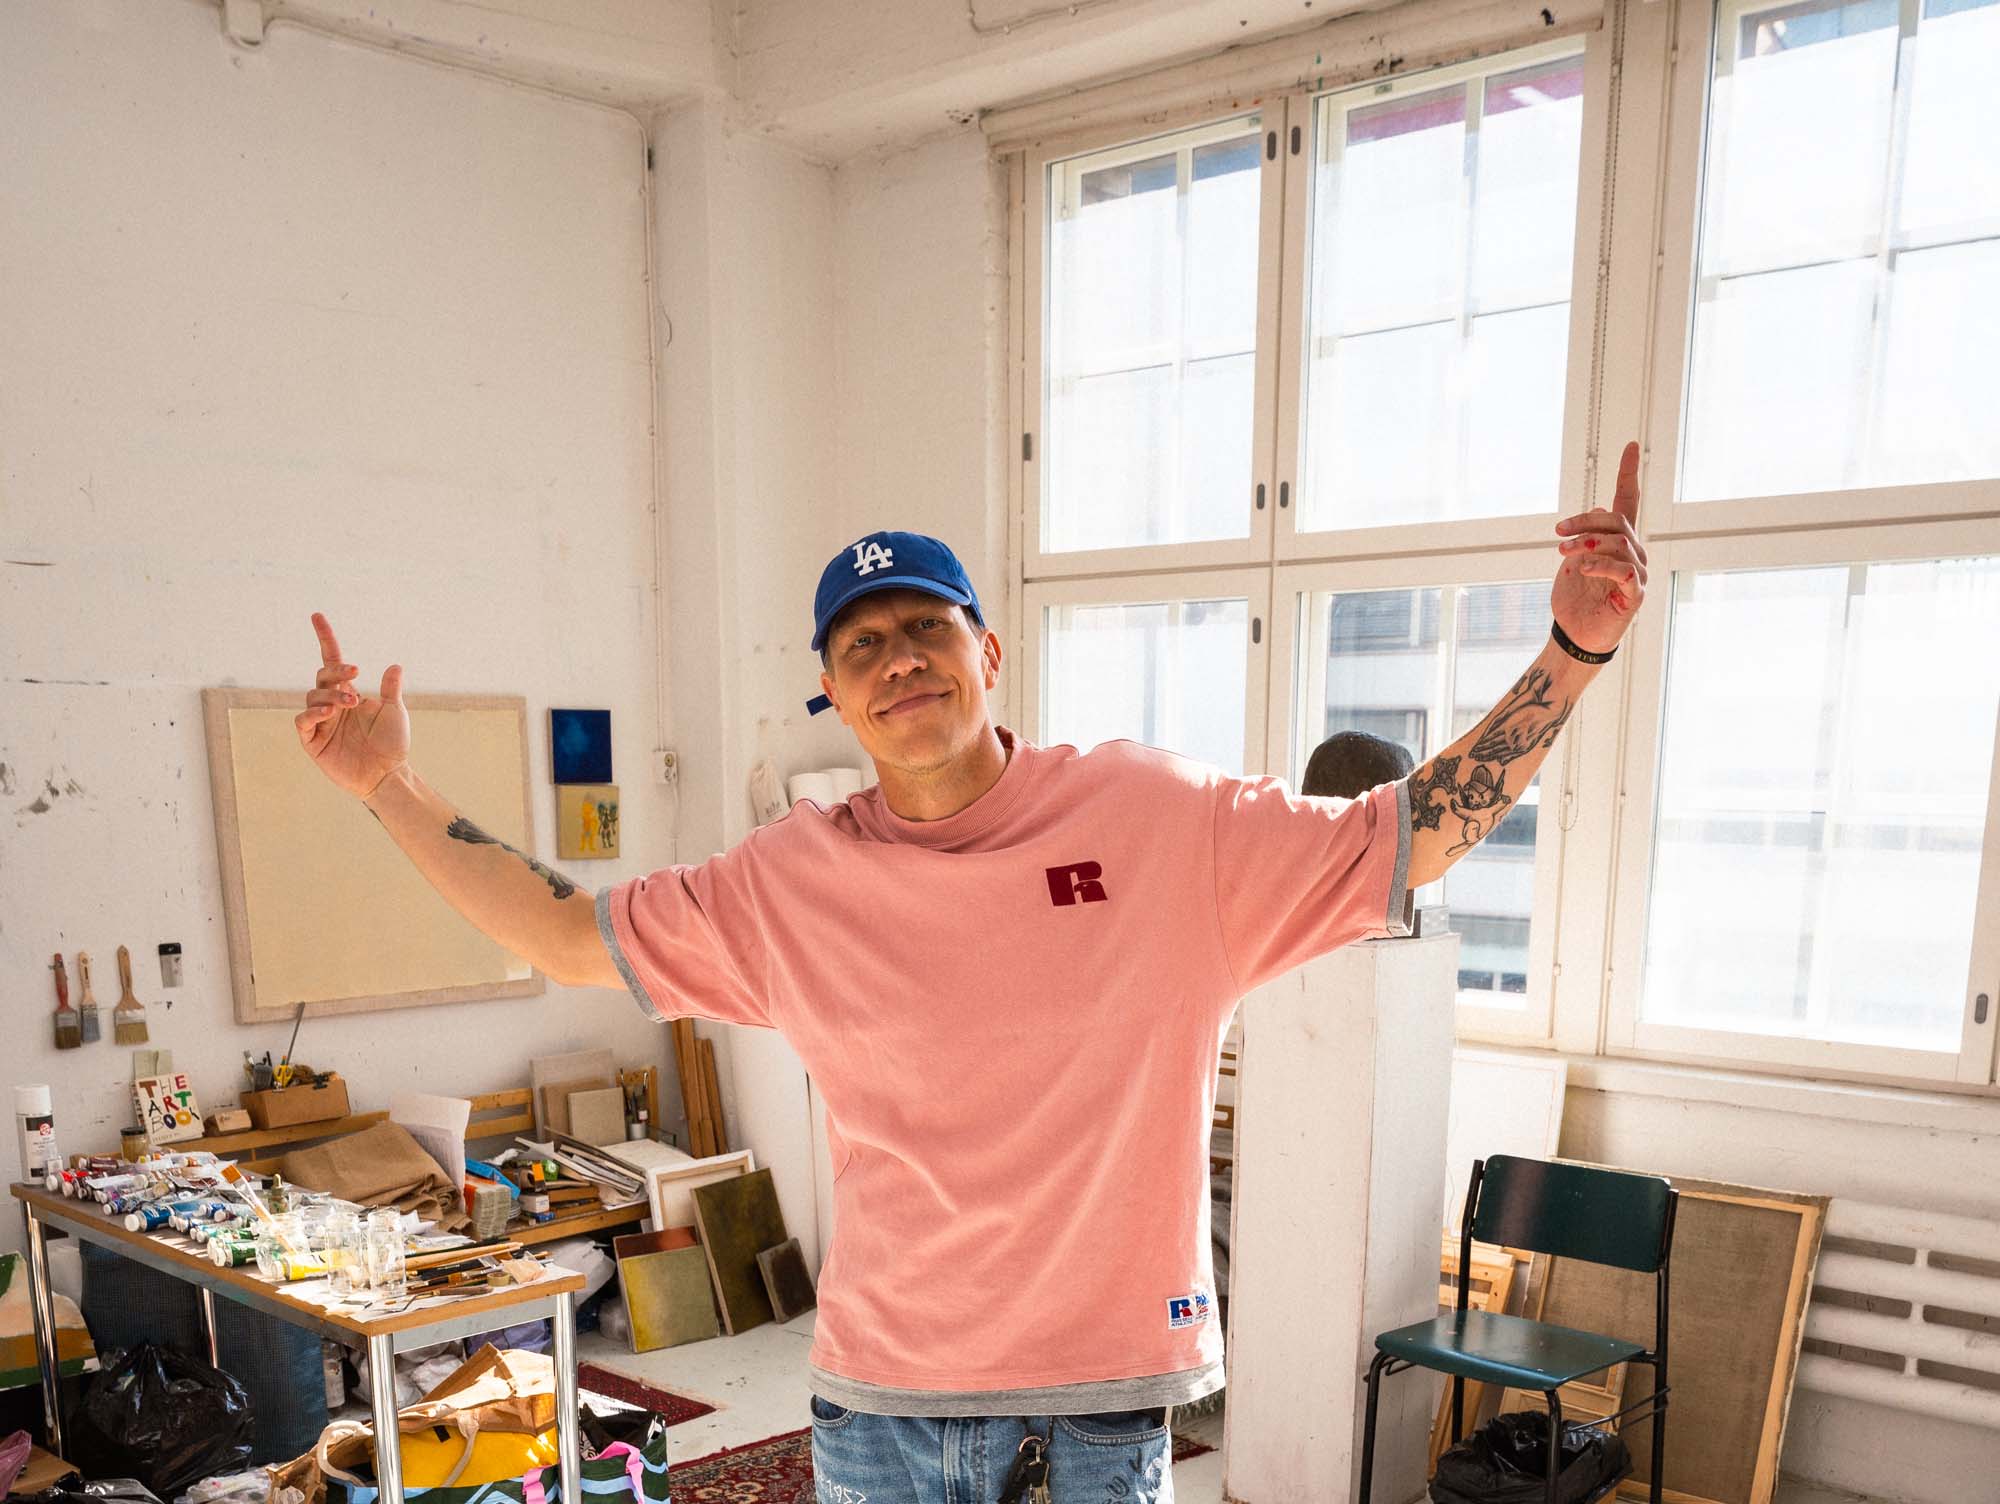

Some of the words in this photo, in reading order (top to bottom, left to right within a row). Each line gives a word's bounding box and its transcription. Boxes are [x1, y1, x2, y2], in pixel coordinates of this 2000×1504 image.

[853, 541, 893, 576] LA
[1046, 861, 1107, 906] R
[139, 1075, 187, 1098] THE
[148, 1091, 192, 1117] ART
